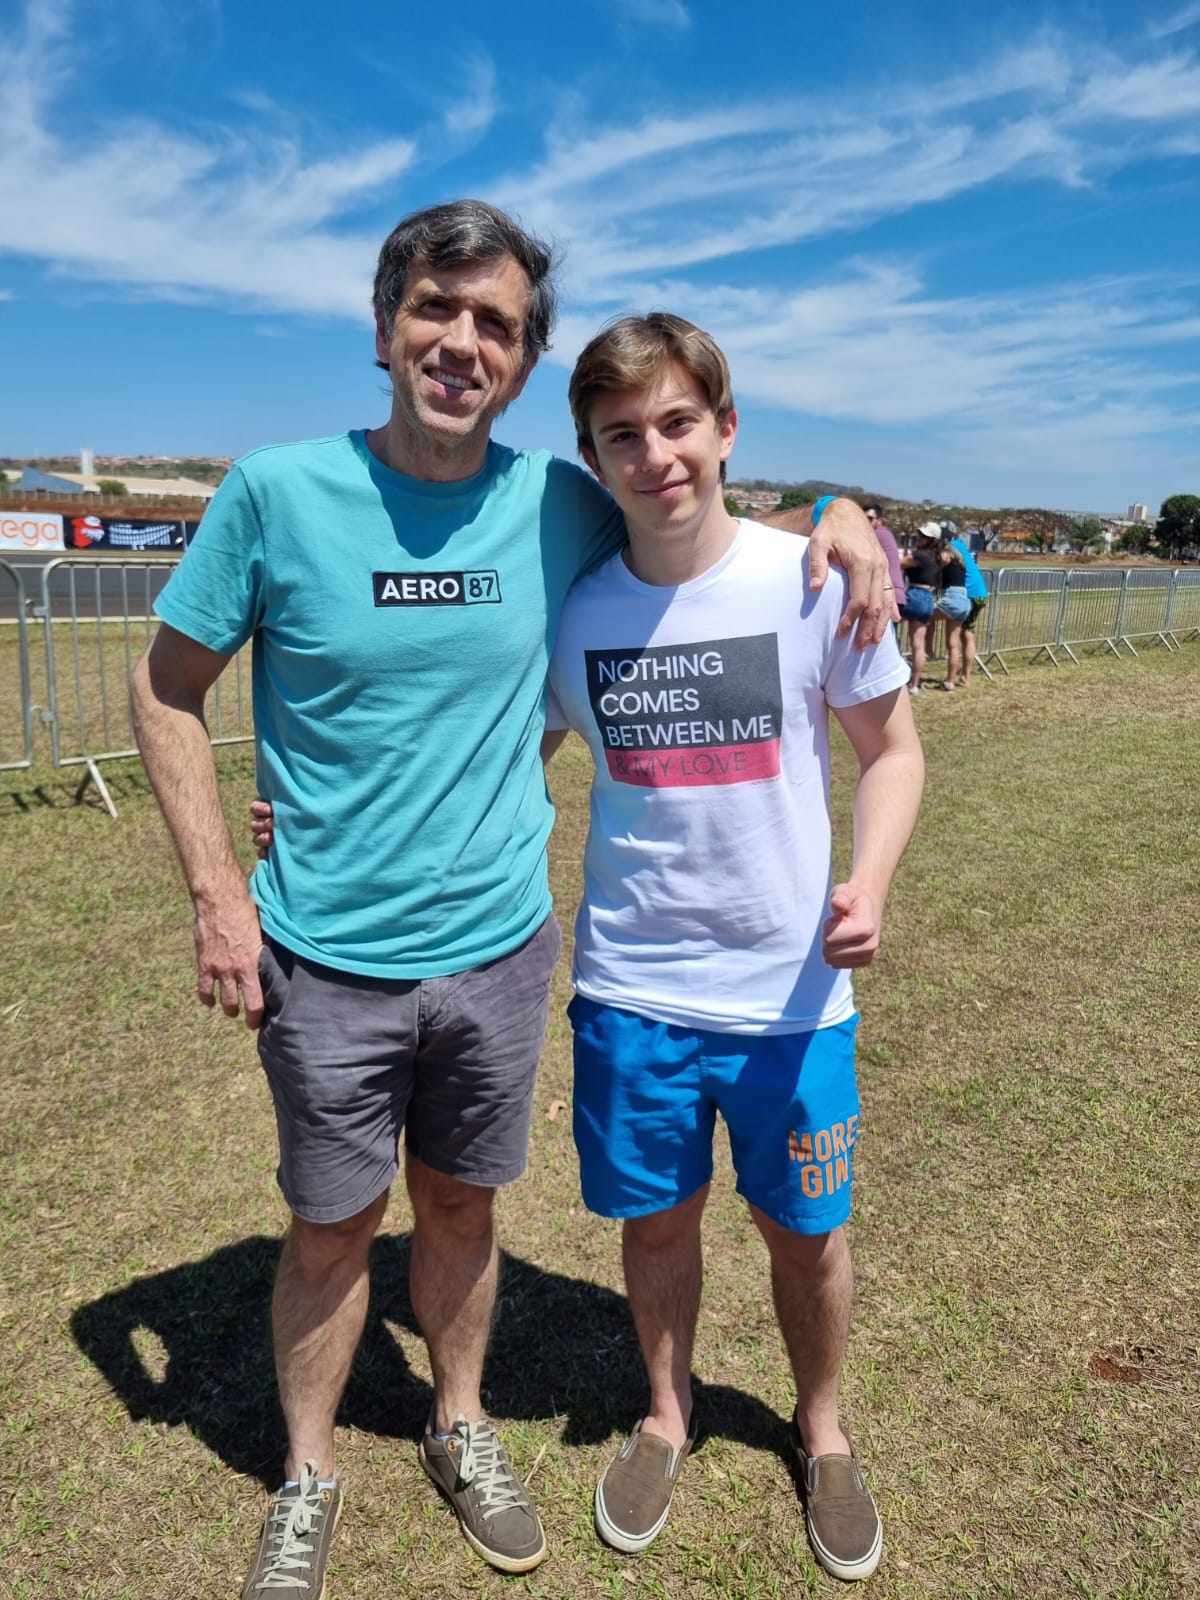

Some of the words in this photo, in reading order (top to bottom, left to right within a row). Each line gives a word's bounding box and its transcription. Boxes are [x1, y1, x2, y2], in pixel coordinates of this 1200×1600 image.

[0, 519, 59, 546] ega
[381, 578, 460, 600] AERO
[469, 576, 494, 598] 87
[598, 652, 724, 683] NOTHING
[600, 688, 700, 716] COMES
[606, 719, 725, 747] BETWEEN
[732, 715, 772, 741] ME
[616, 755, 629, 776] &
[634, 755, 672, 777] MY
[680, 751, 748, 777] LOVE
[789, 1114, 858, 1162] MORE
[801, 1152, 848, 1198] GIN
